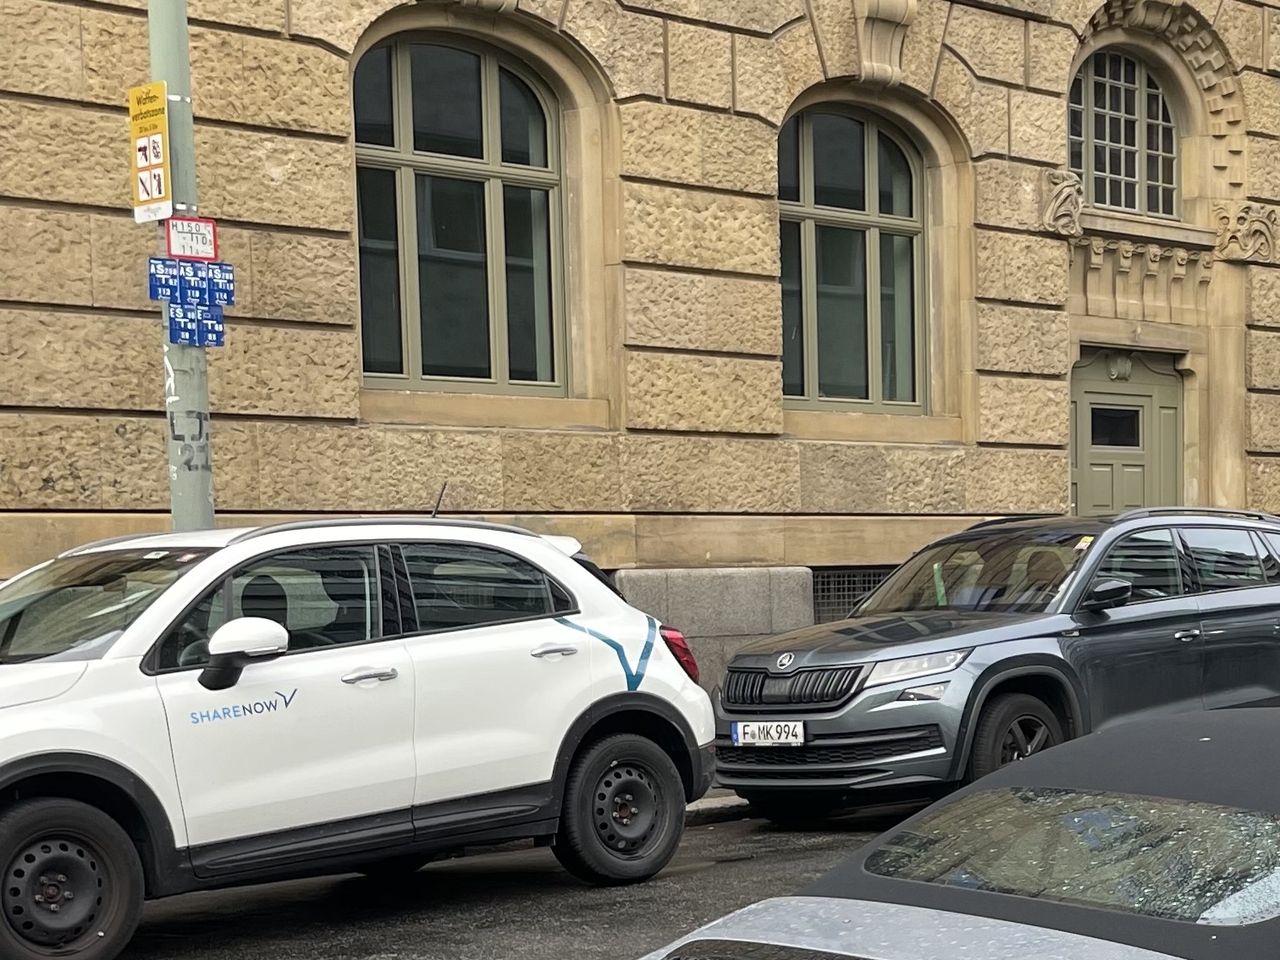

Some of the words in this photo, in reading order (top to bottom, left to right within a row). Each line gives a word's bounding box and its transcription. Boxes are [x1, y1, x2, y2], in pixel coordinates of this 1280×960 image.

[742, 724, 750, 740] F
[757, 724, 774, 740] MK
[775, 723, 799, 740] 994
